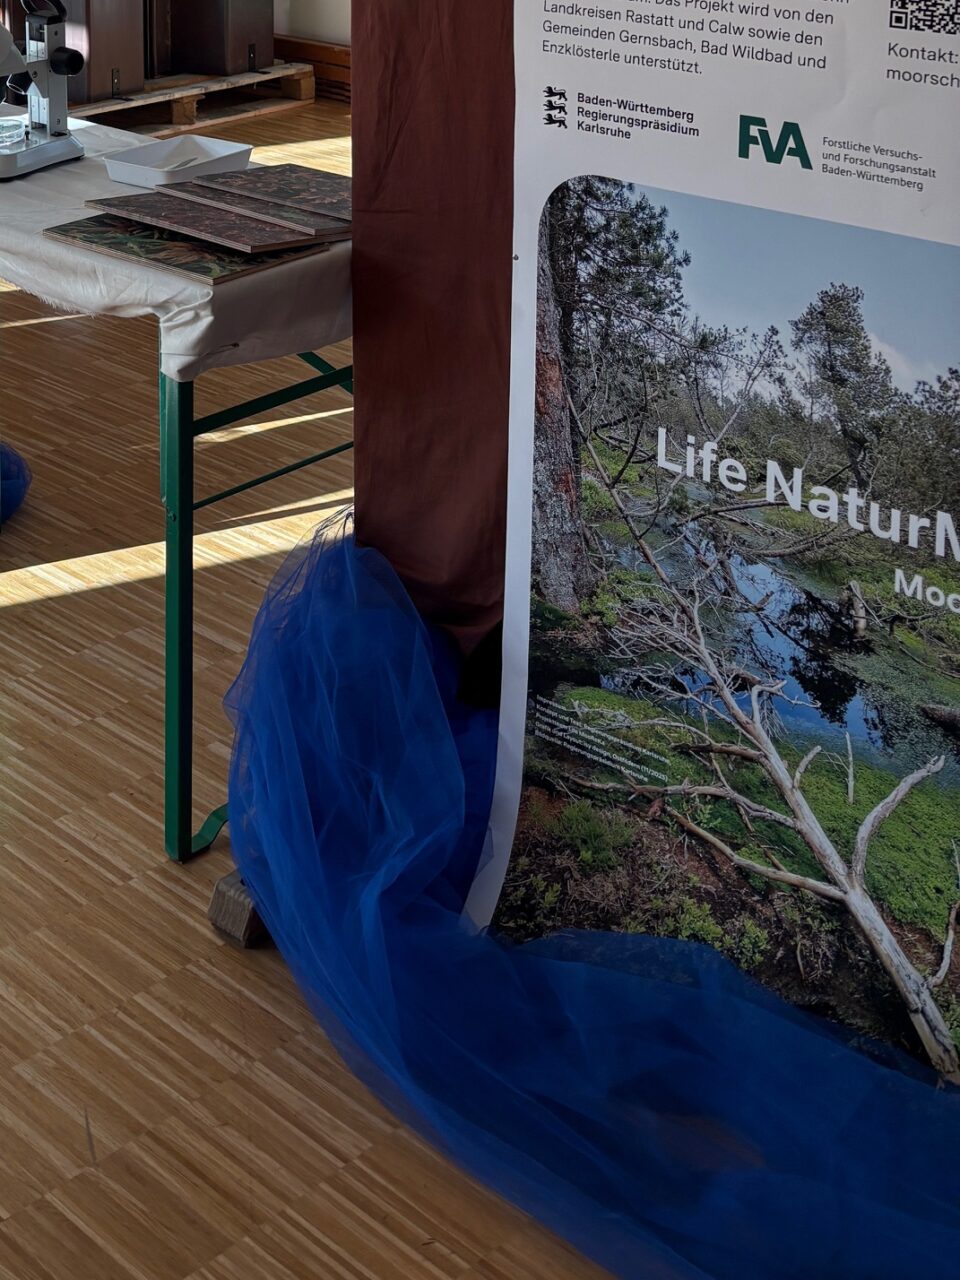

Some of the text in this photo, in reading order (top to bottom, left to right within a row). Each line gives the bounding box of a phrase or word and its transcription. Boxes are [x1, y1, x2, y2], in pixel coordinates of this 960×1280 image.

[544, 0, 823, 46] Landkreisen Rastatt und Calw sowie den
[738, 2, 769, 17] wird
[773, 8, 800, 21] von
[805, 9, 834, 25] den
[542, 39, 702, 74] Enzklösterle unterstützt.
[543, 20, 826, 69] Gemeinden Gernsbach, Bad Wildbad und
[888, 42, 959, 64] Kontakt:
[886, 69, 960, 88] moorsch
[577, 92, 694, 122] Baden-Württemberg
[577, 106, 699, 137] Regierungspräsidium
[577, 120, 631, 139] Karlsruhe
[738, 114, 813, 170] FVA
[823, 136, 923, 161] Forstliche Versuchs-
[822, 152, 936, 178] und Forschungsanstalt
[822, 163, 924, 191] Baden-Württemberg
[657, 427, 747, 492] Life
